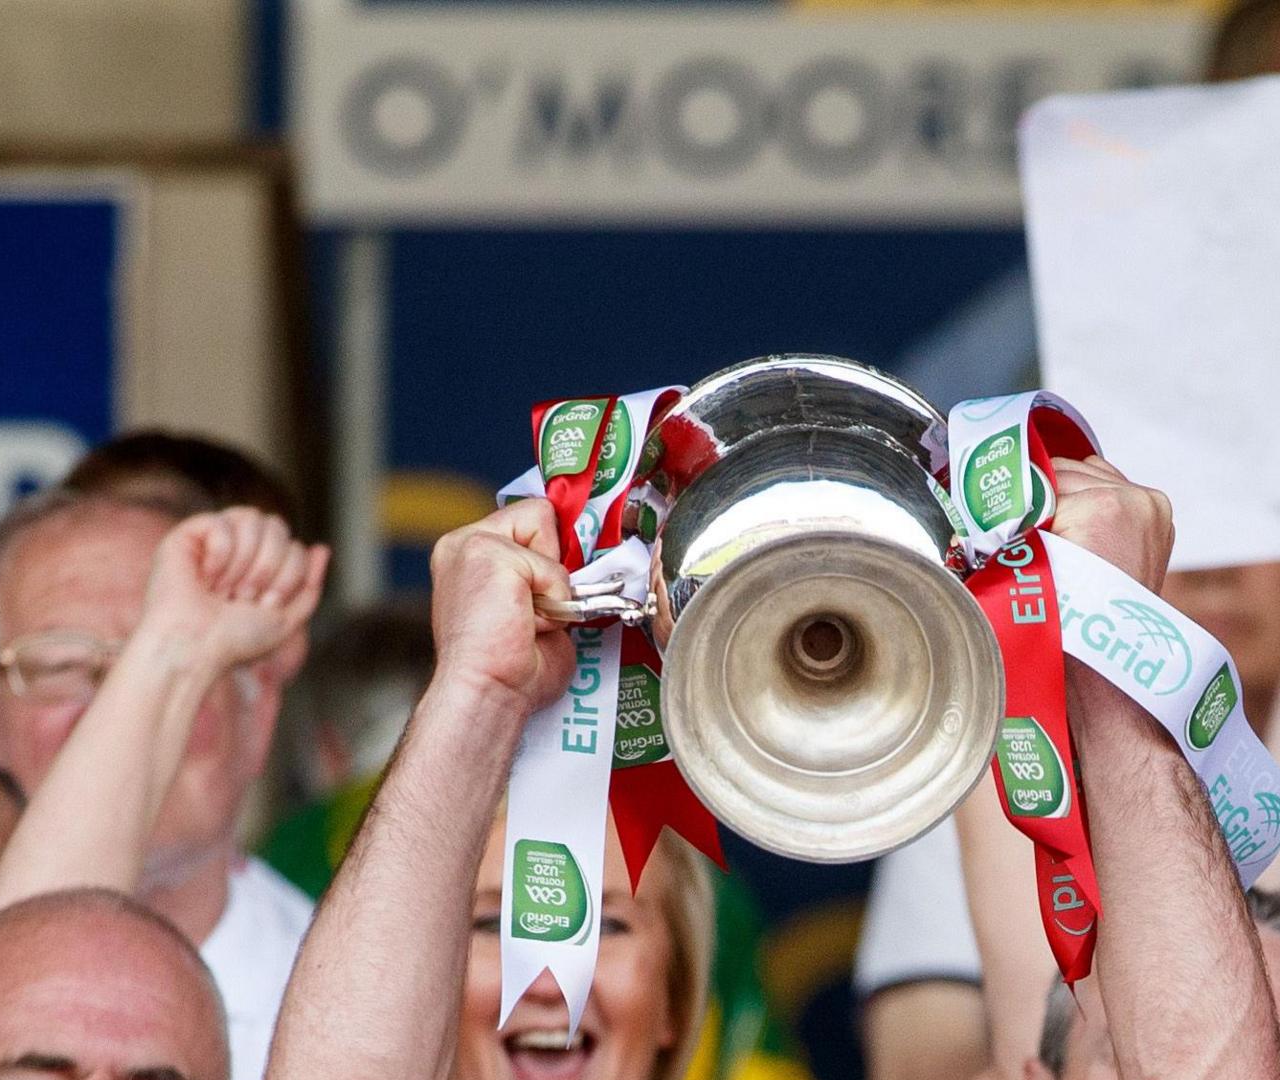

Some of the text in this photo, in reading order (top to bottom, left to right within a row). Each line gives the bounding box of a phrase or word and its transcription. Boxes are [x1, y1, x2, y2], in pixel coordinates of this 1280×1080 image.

[975, 444, 1010, 468] EirGrid
[620, 734, 664, 751] EirGrid
[1010, 741, 1032, 752] U20
[1008, 762, 1044, 780] GAA
[1017, 789, 1053, 801] EirGrid
[533, 864, 559, 877] U20
[524, 884, 567, 906] GAA
[527, 912, 570, 928] EirGrid
